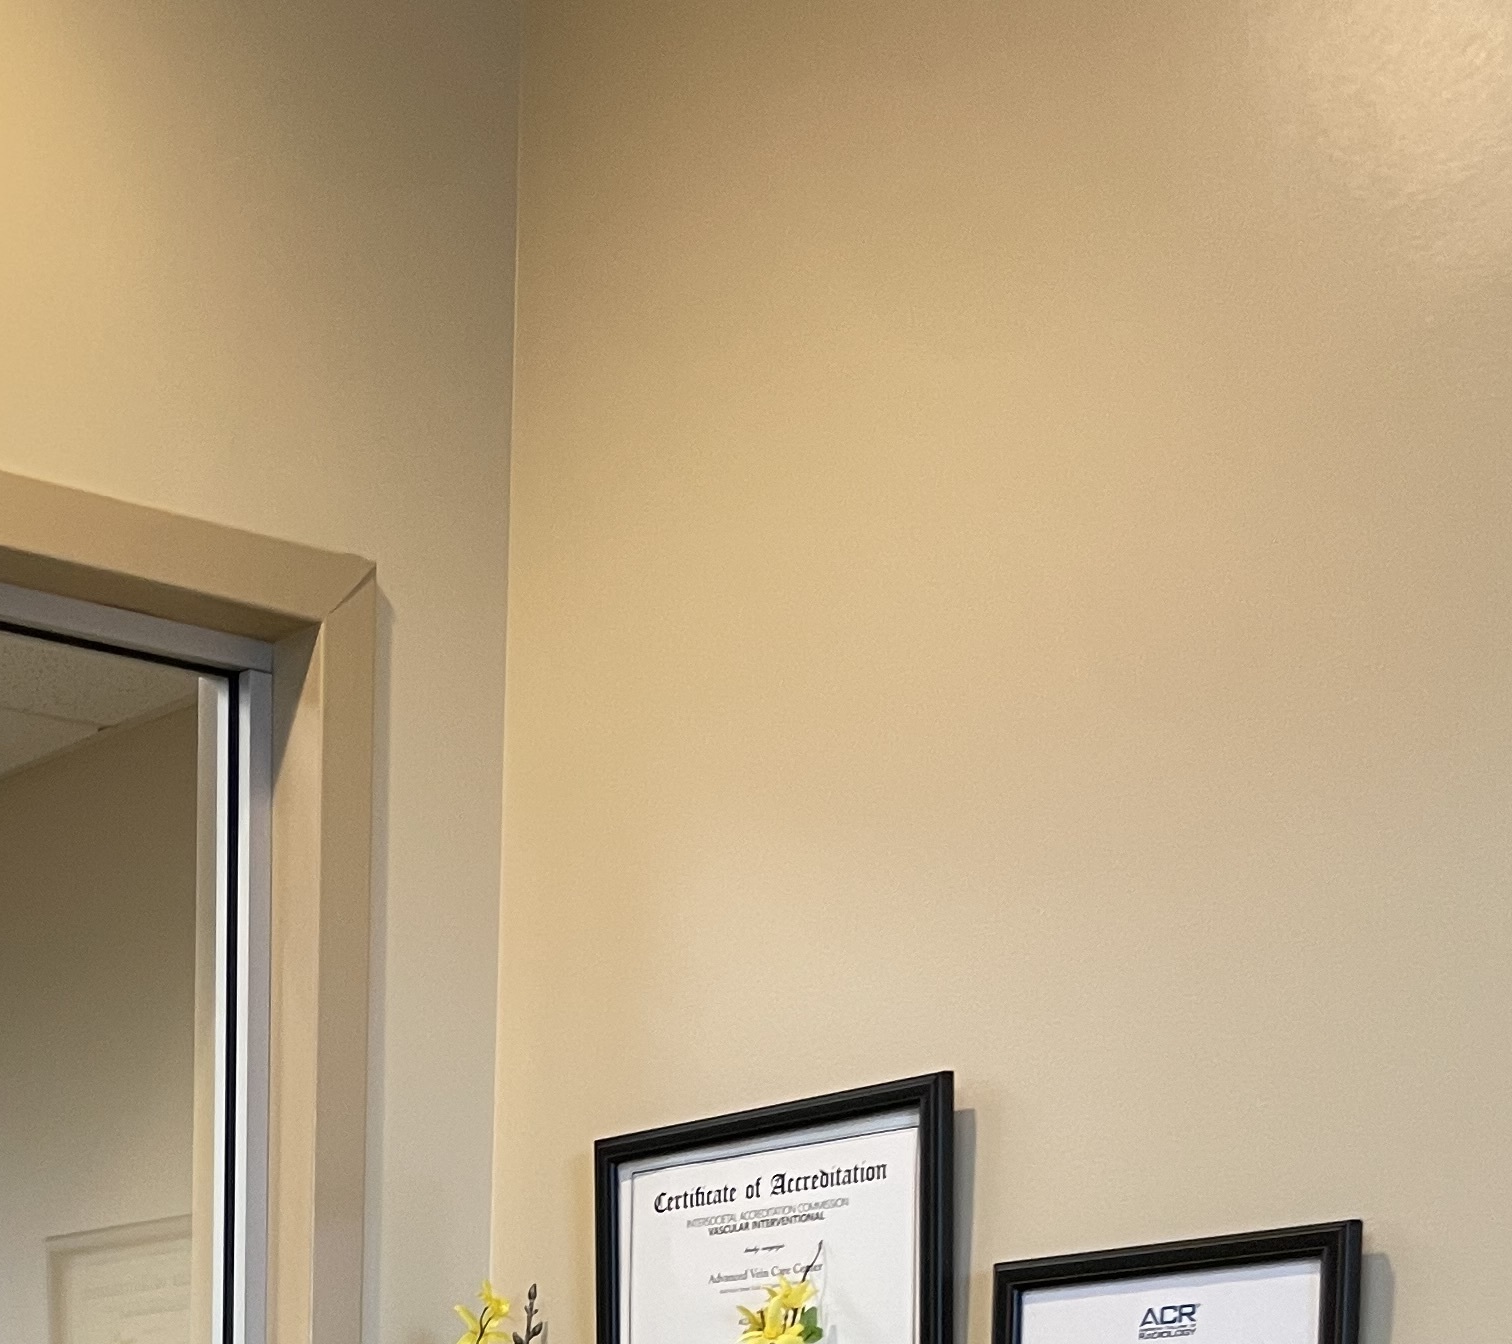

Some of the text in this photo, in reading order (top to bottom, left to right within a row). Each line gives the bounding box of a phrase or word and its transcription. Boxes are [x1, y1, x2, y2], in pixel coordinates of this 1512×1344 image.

[653, 1160, 887, 1213] Certificate of Accreditation
[708, 1222, 750, 1236] VASCULAR
[1139, 1303, 1197, 1328] ACR
